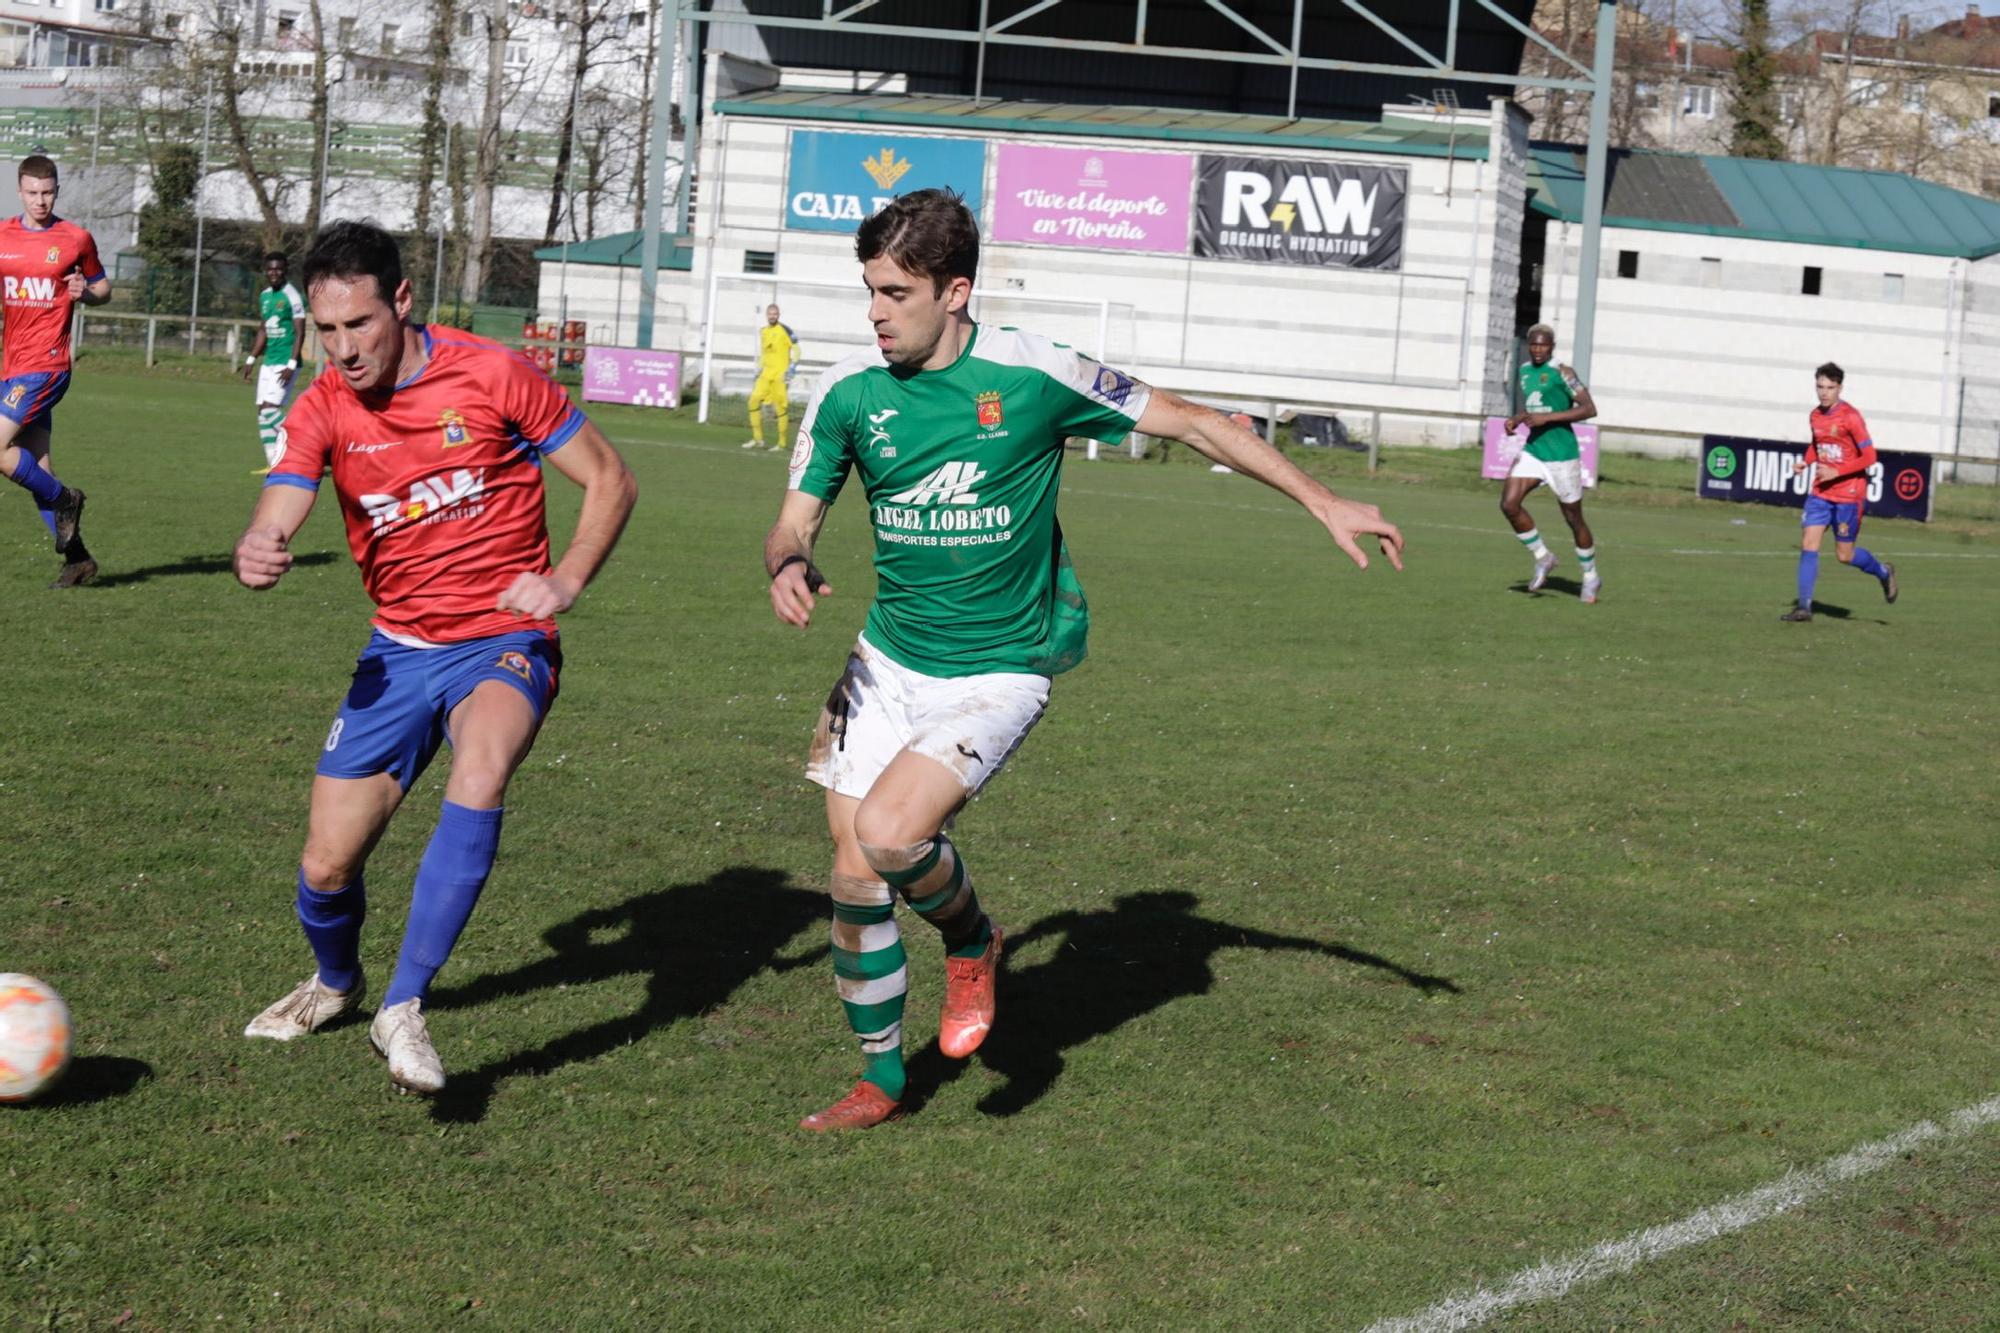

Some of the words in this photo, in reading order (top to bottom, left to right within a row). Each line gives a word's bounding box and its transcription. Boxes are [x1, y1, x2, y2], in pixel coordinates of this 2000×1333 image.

[792, 192, 864, 220] CAJA
[1016, 188, 1065, 210] Vive
[1066, 191, 1087, 211] el
[1088, 193, 1169, 219] deporte
[1221, 170, 1379, 236] RAW
[1032, 218, 1059, 235] en
[1060, 216, 1146, 240] Noreña
[1219, 230, 1282, 249] ORGANIC
[1289, 235, 1369, 255] HYDRATION
[4, 276, 56, 301] RAW
[359, 467, 485, 529] RAW
[929, 505, 1011, 531] LOBETO
[940, 530, 1012, 547] ESPECIALES
[325, 718, 344, 751] 8
